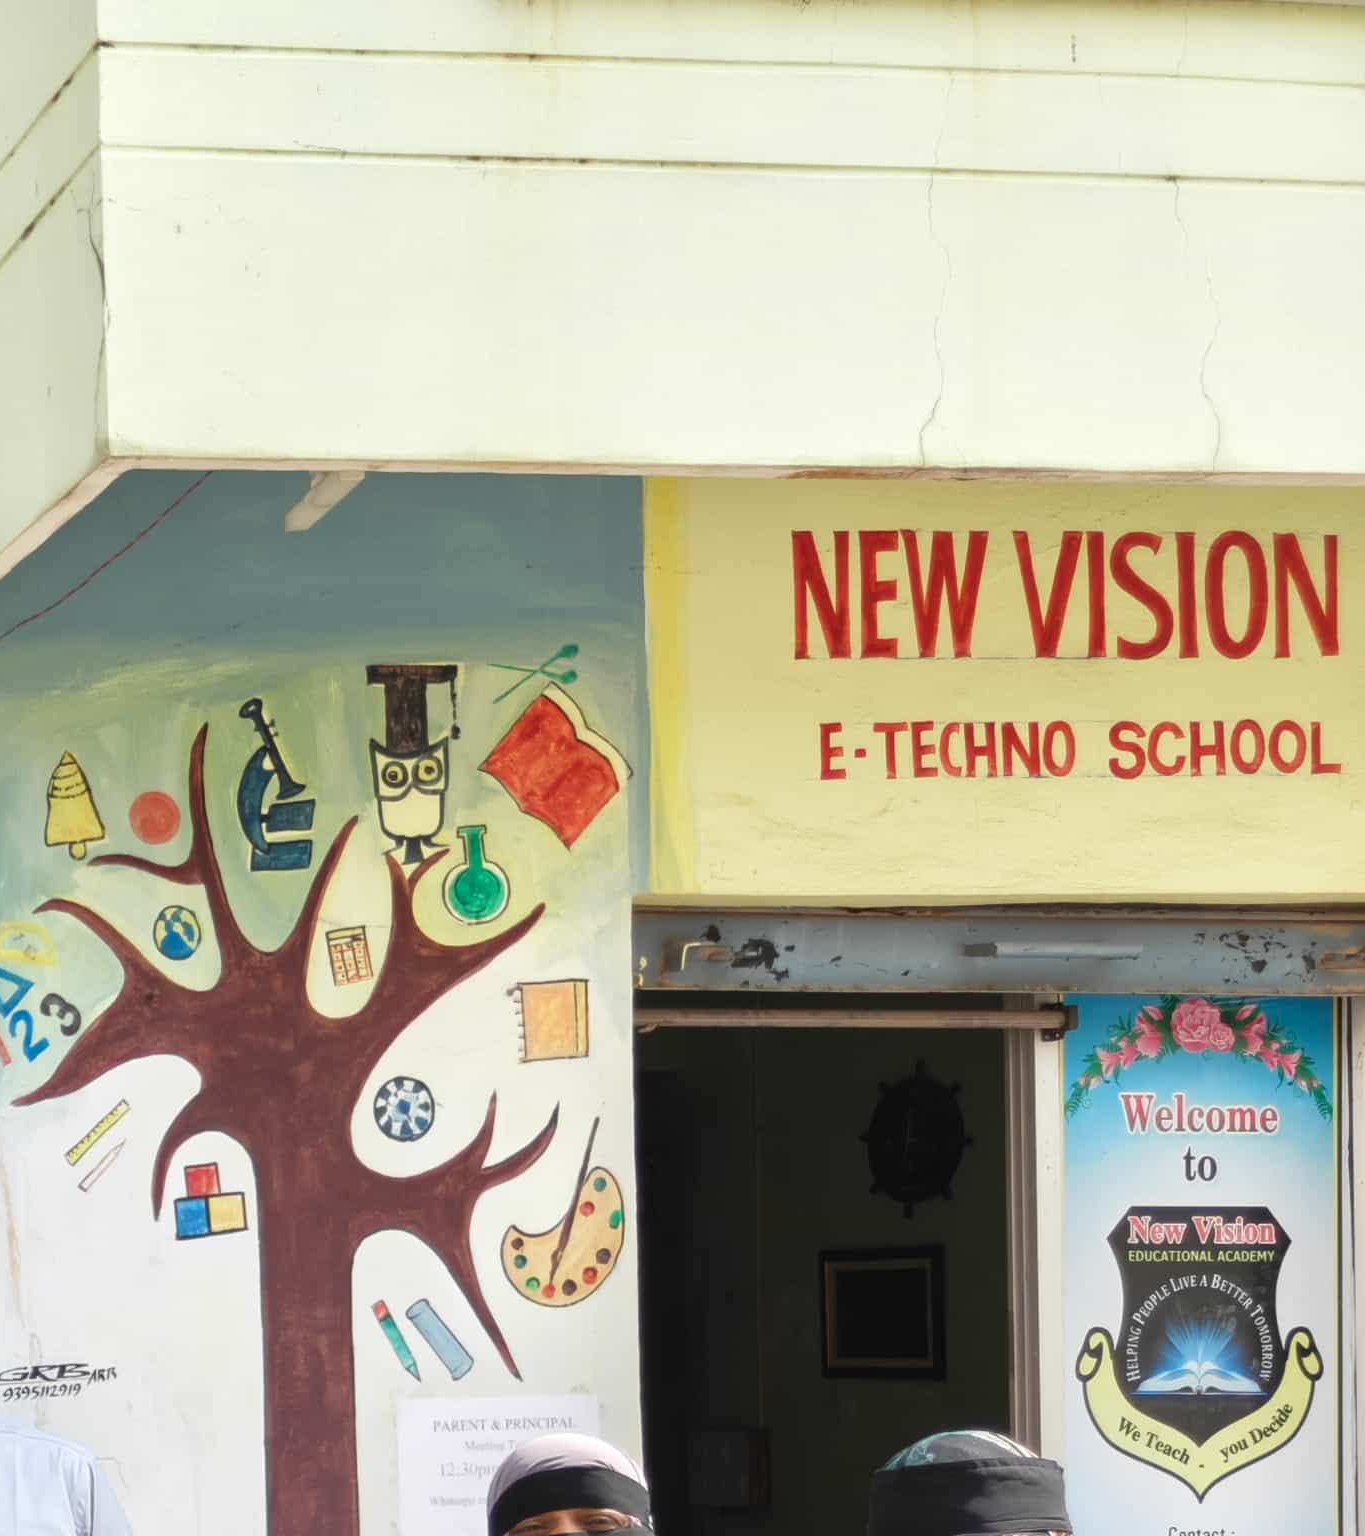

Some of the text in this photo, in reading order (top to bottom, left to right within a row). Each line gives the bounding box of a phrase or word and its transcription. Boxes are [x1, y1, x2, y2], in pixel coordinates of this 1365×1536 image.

[792, 528, 1340, 660] NEW VISION
[819, 719, 1342, 780] E-TECHNO SCHOOL
[1119, 1092, 1279, 1135] Welcome
[1183, 1145, 1217, 1181] to
[1127, 1216, 1276, 1244] New Vision
[1128, 1250, 1275, 1262] EDUCATIONAL ACADEMY
[433, 1416, 575, 1433] PARENT & PRINCIPAL
[1118, 1416, 1141, 1442] We
[1145, 1431, 1190, 1465] Teach
[1219, 1442, 1249, 1463] you
[1249, 1402, 1293, 1443] Decide
